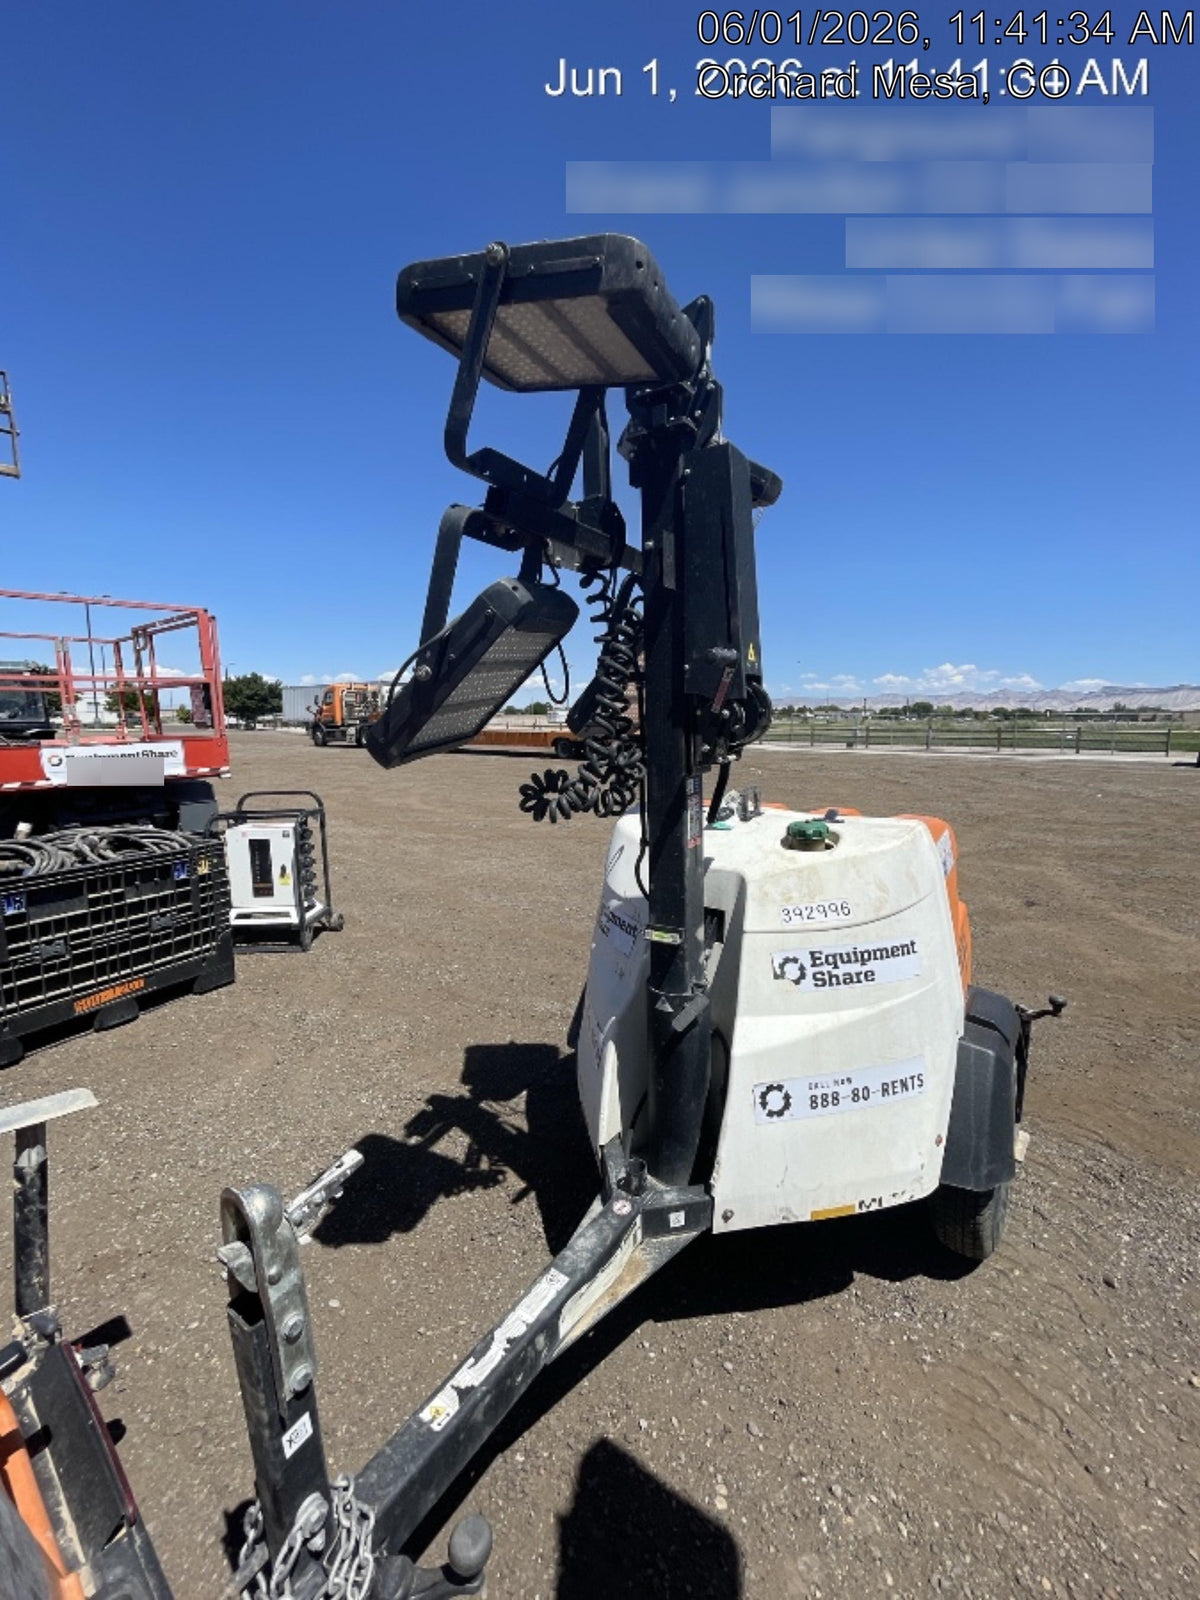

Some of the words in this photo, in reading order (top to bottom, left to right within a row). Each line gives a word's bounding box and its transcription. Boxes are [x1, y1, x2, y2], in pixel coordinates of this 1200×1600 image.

[781, 900, 851, 923] 392996
[808, 939, 917, 969] Equipment
[811, 969, 876, 988] Share
[808, 1073, 925, 1110] 888-80-RENTS
